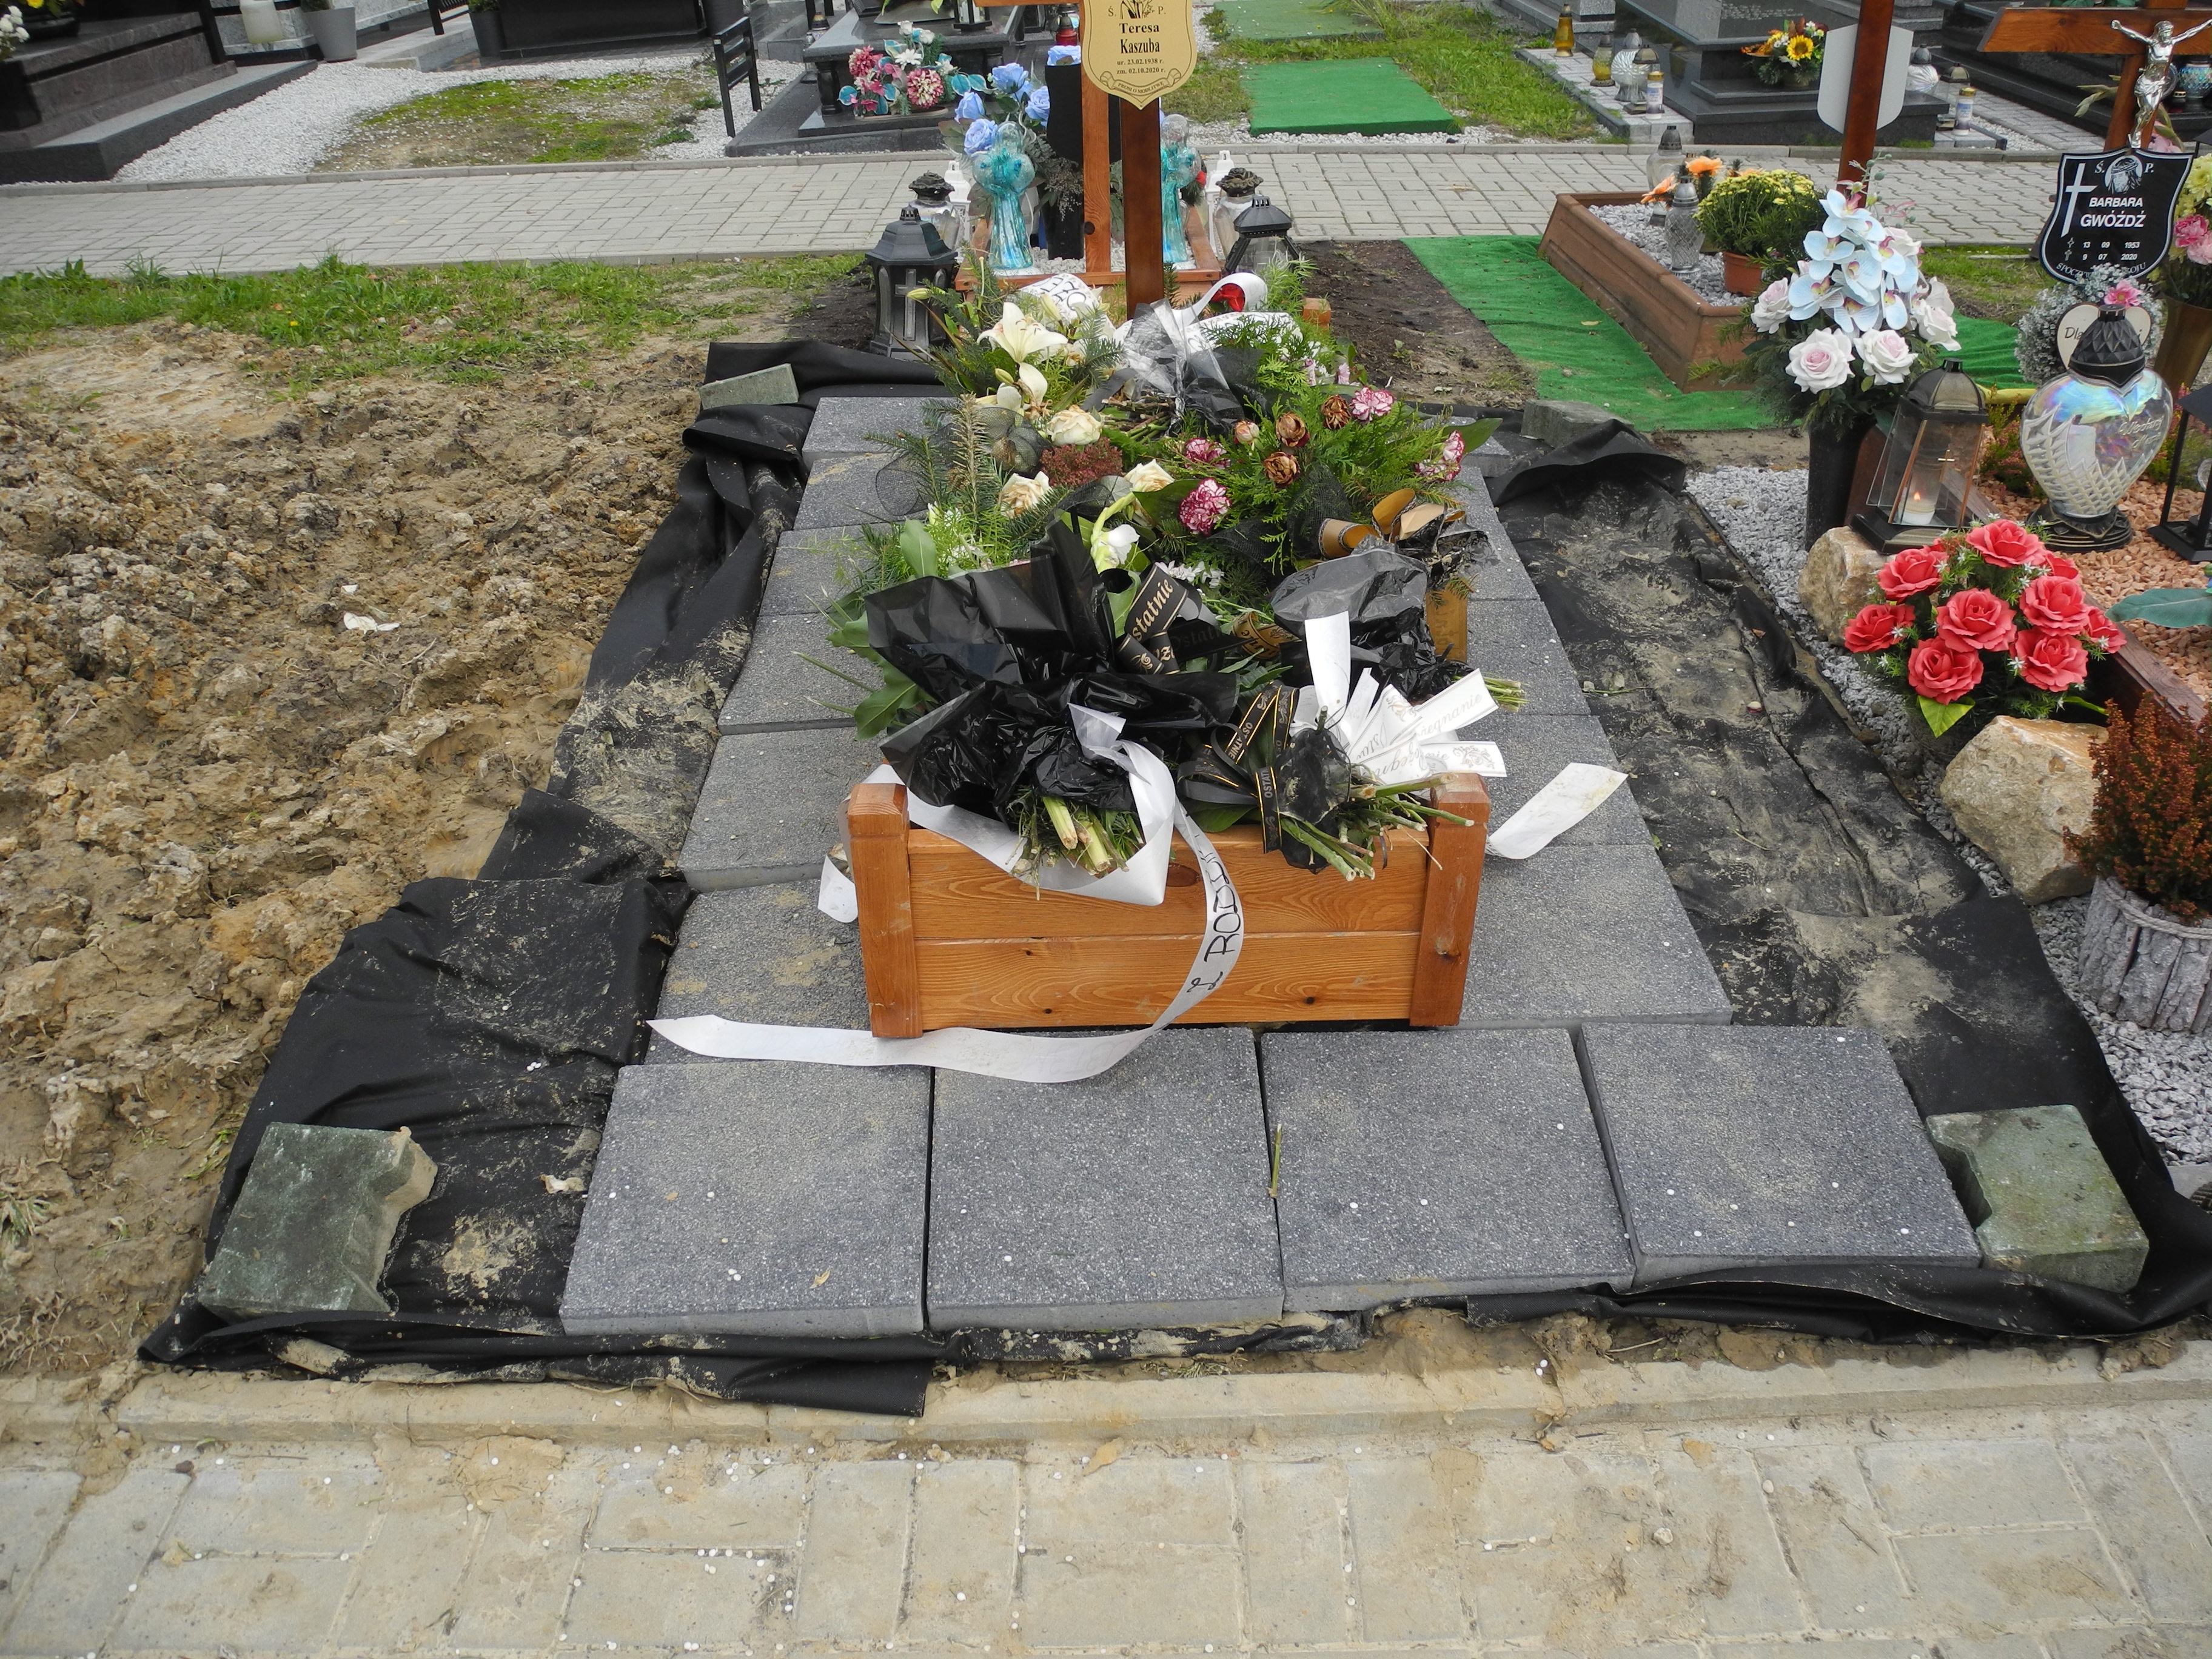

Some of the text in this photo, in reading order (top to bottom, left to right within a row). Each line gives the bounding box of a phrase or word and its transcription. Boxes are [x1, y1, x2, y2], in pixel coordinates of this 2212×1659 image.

[1119, 22, 1159, 34] Teresa
[1120, 38, 1160, 54] Kaszuba
[1118, 82, 1132, 92] PROSI
[2089, 197, 2143, 207] BARBARA
[2080, 210, 2147, 227] GWÓŹDŹ
[1132, 579, 1173, 642] statnie
